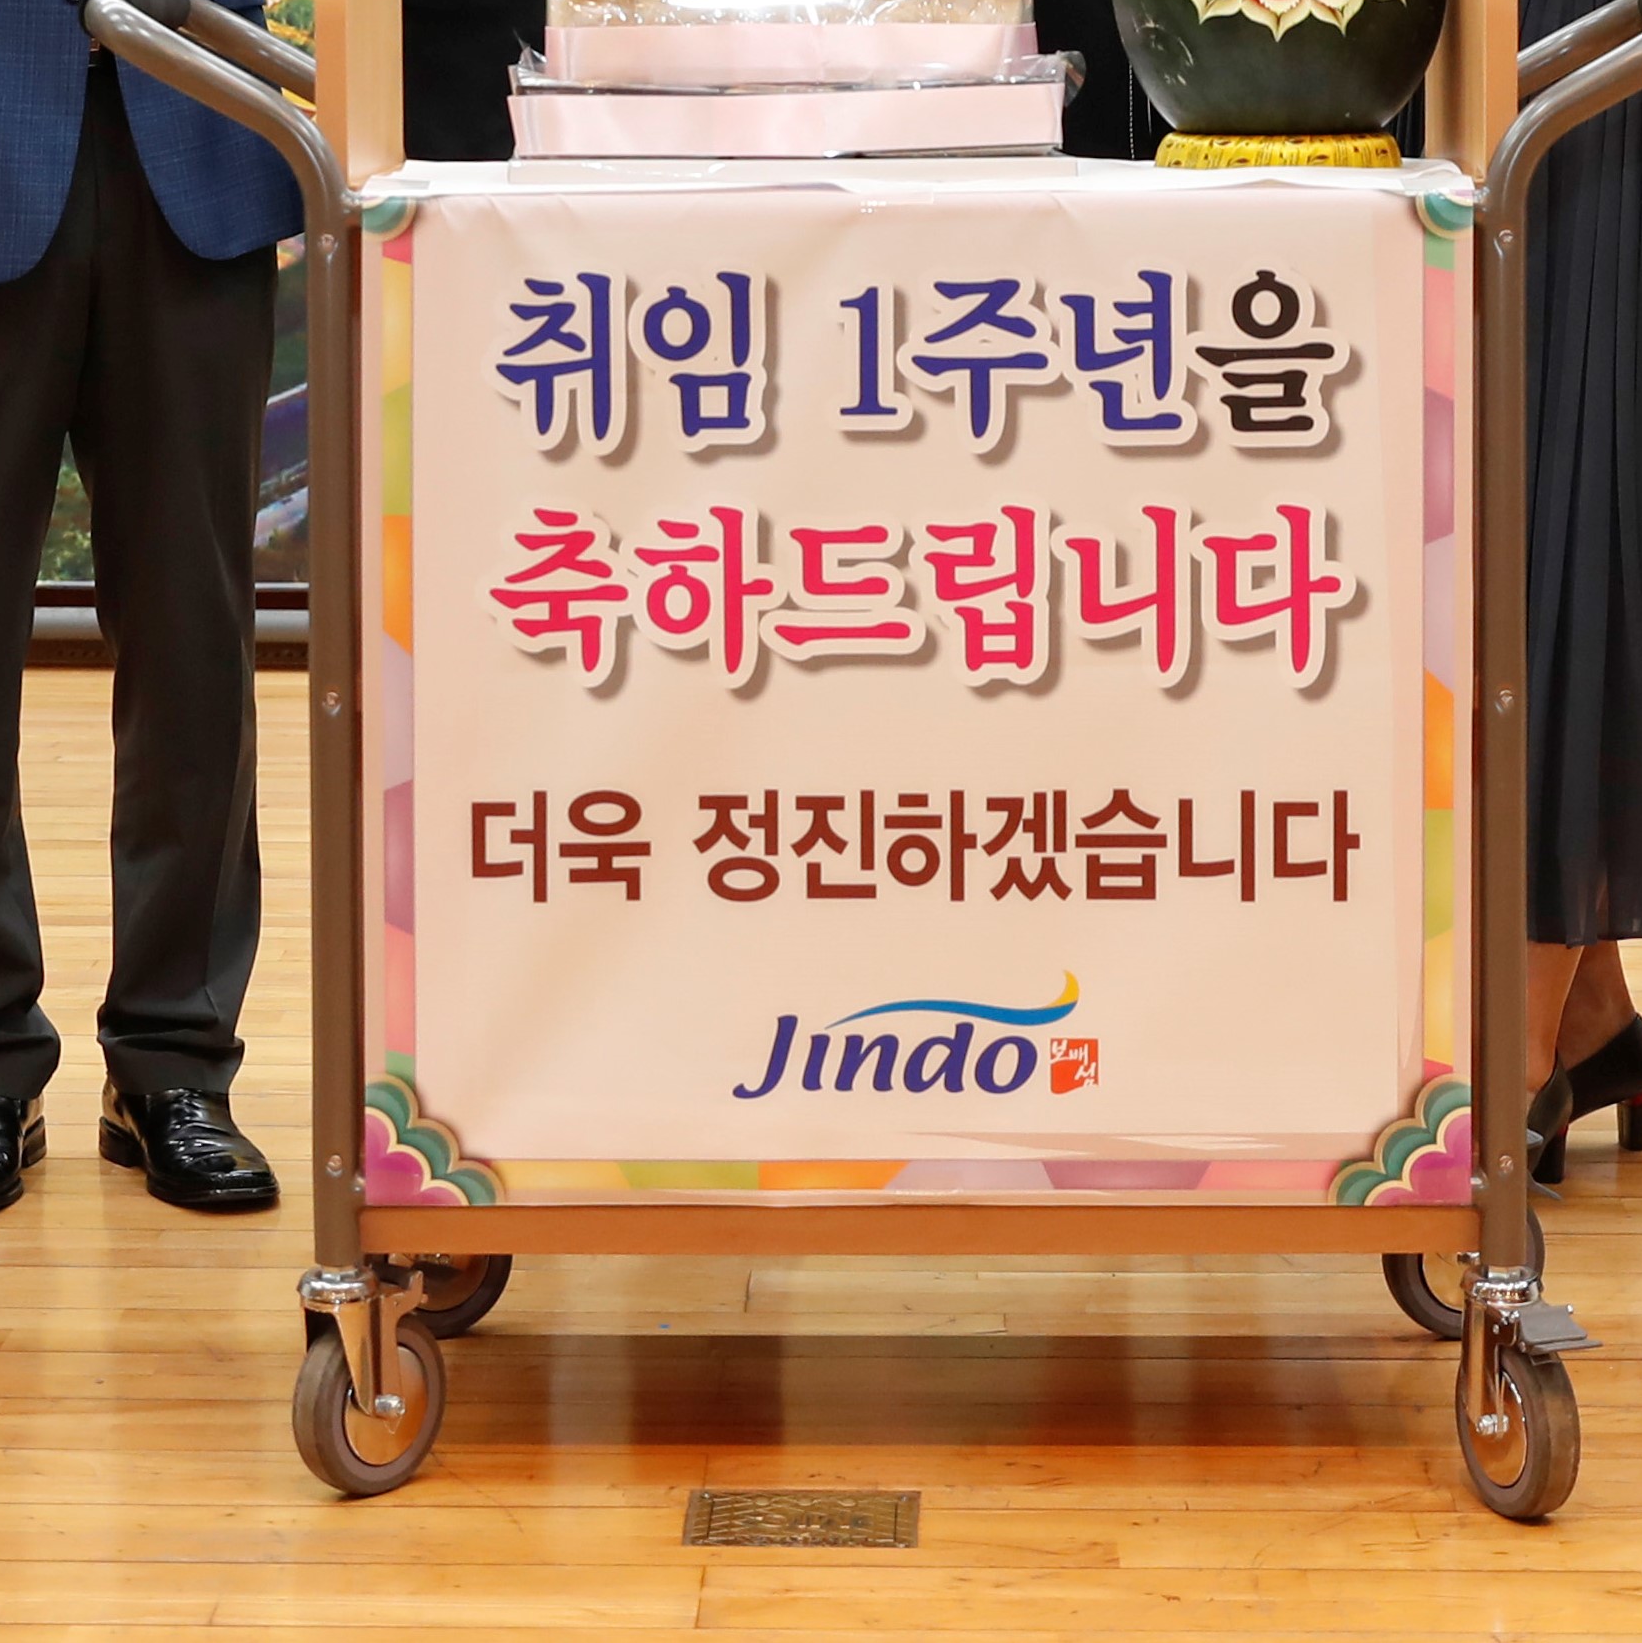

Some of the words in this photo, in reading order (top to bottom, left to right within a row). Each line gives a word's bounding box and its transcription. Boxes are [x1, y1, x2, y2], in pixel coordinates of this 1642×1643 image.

[497, 273, 751, 439] 취임
[840, 271, 1335, 437] 1주년을
[490, 505, 1341, 673] 축하드립니다
[472, 791, 651, 902] 더욱
[694, 790, 1360, 902] 정진하겠습니다
[733, 1015, 1038, 1099] Jindo
